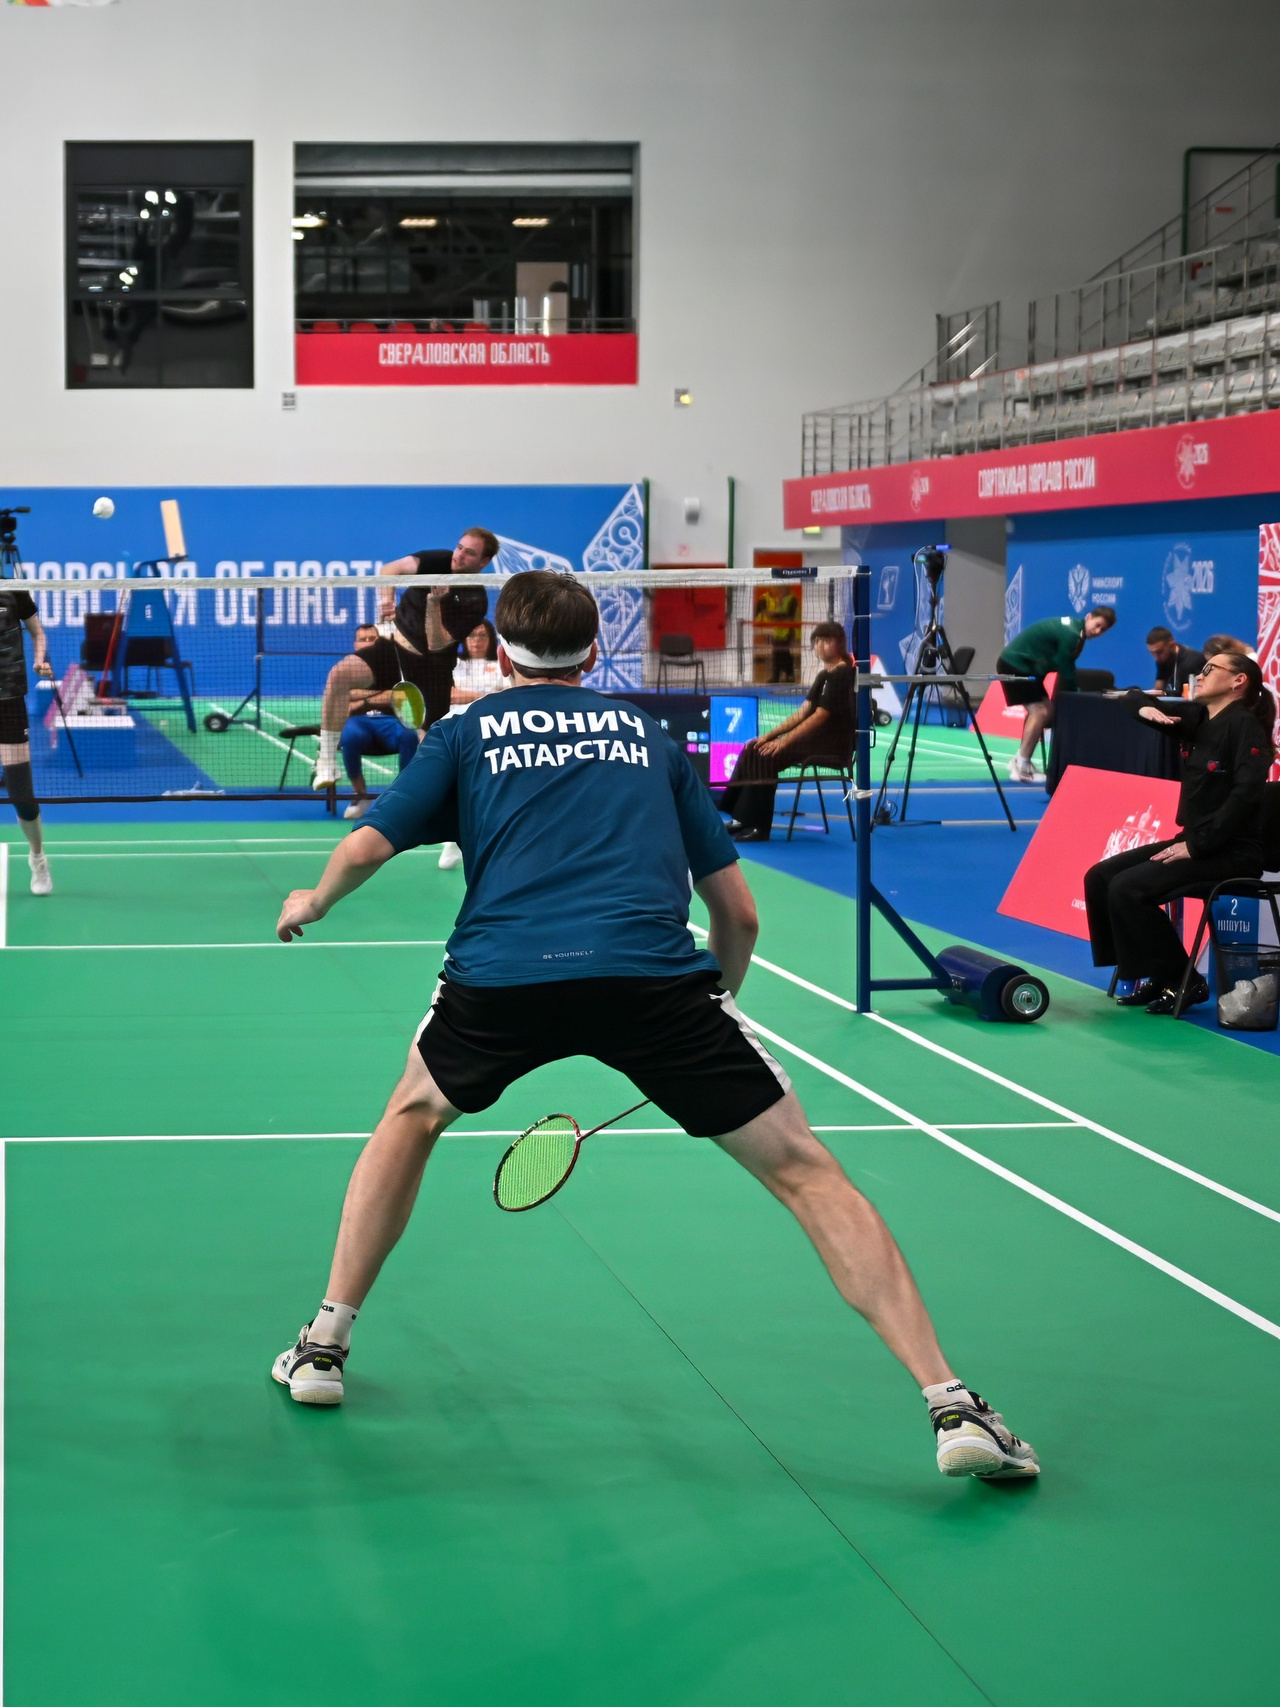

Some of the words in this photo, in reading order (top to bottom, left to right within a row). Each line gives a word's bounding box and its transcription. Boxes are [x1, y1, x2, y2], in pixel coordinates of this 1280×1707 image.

[378, 343, 486, 366] СВЕРДЛОВСКАЯ
[490, 342, 551, 366] ОБЛАСТЬ
[479, 709, 646, 740] МОНИЧ
[725, 707, 742, 733] 7
[484, 739, 649, 775] ТАТАРСТАН
[1231, 898, 1238, 915] 2
